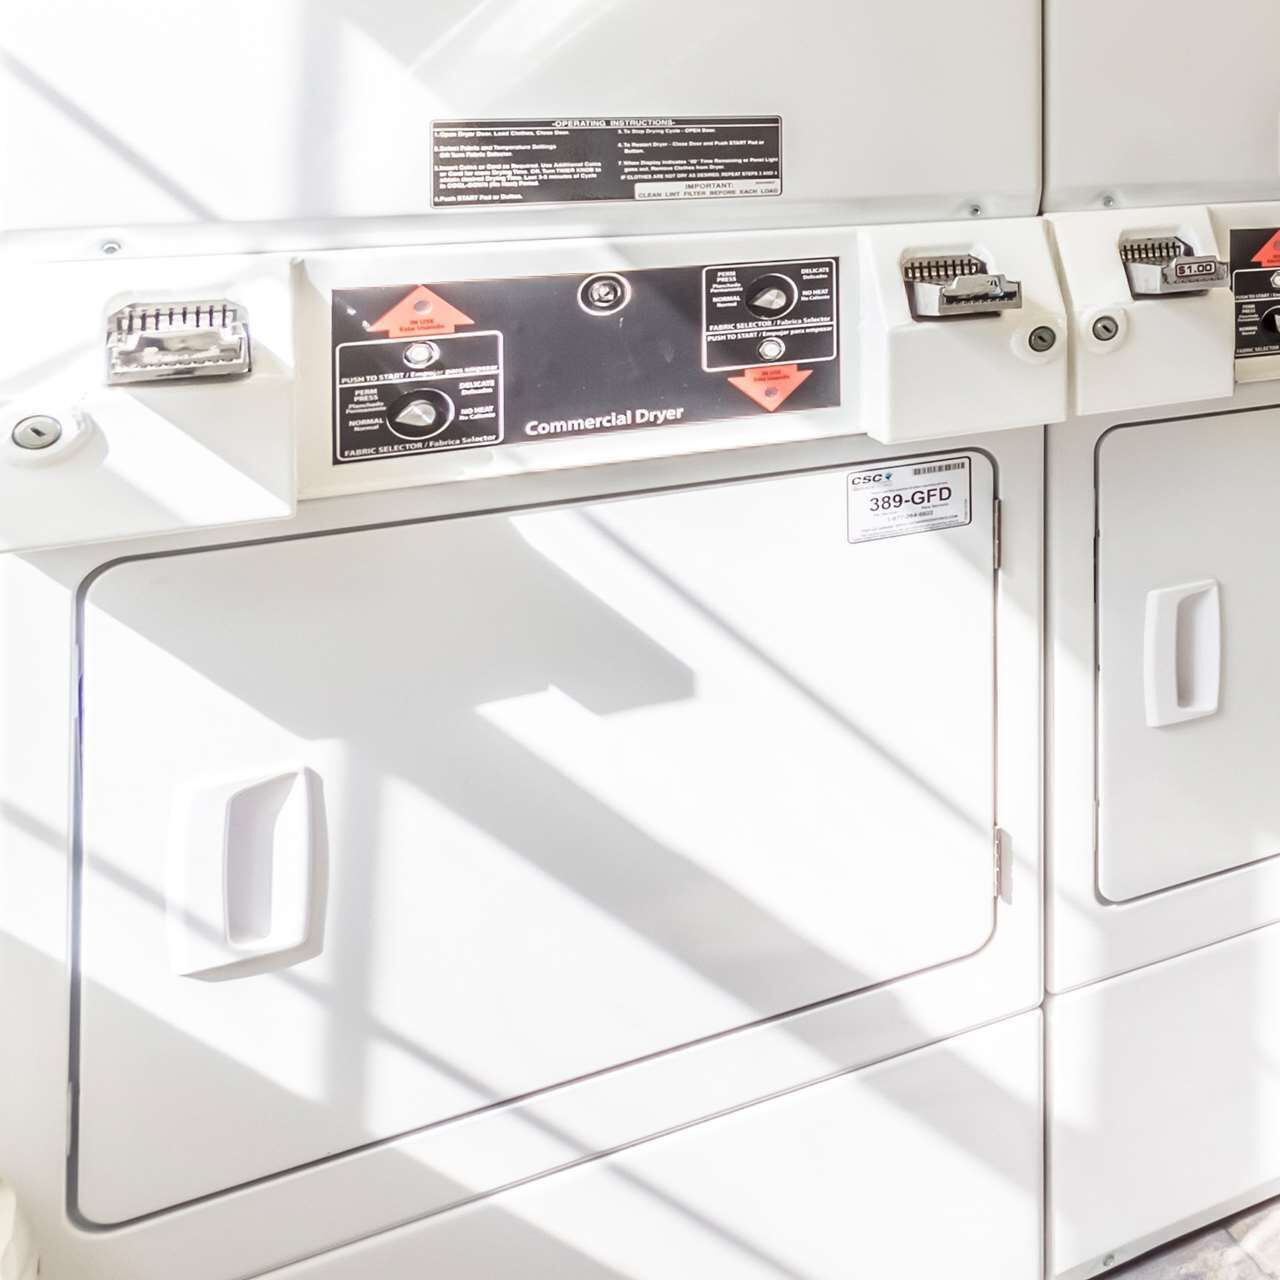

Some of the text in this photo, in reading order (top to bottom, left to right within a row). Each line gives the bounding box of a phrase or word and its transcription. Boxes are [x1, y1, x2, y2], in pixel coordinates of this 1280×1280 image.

[684, 182, 734, 190] IMPORTANT:
[1178, 263, 1213, 275] $1.00
[709, 323, 735, 331] FABRIC
[736, 320, 773, 329] SELECTOR
[707, 333, 726, 342] PUSH
[737, 331, 757, 339] START
[341, 376, 365, 384] PUSH
[366, 375, 378, 383] TO
[379, 372, 404, 381] START
[354, 388, 377, 396] PERM
[348, 417, 385, 427] NORMAL
[524, 407, 685, 436] Commercial Dryer
[344, 447, 376, 457] FABRIC
[378, 442, 423, 453] SELECTOR
[461, 434, 497, 444] Selector
[851, 473, 883, 486] CSC
[869, 486, 952, 512] 389-GFD
